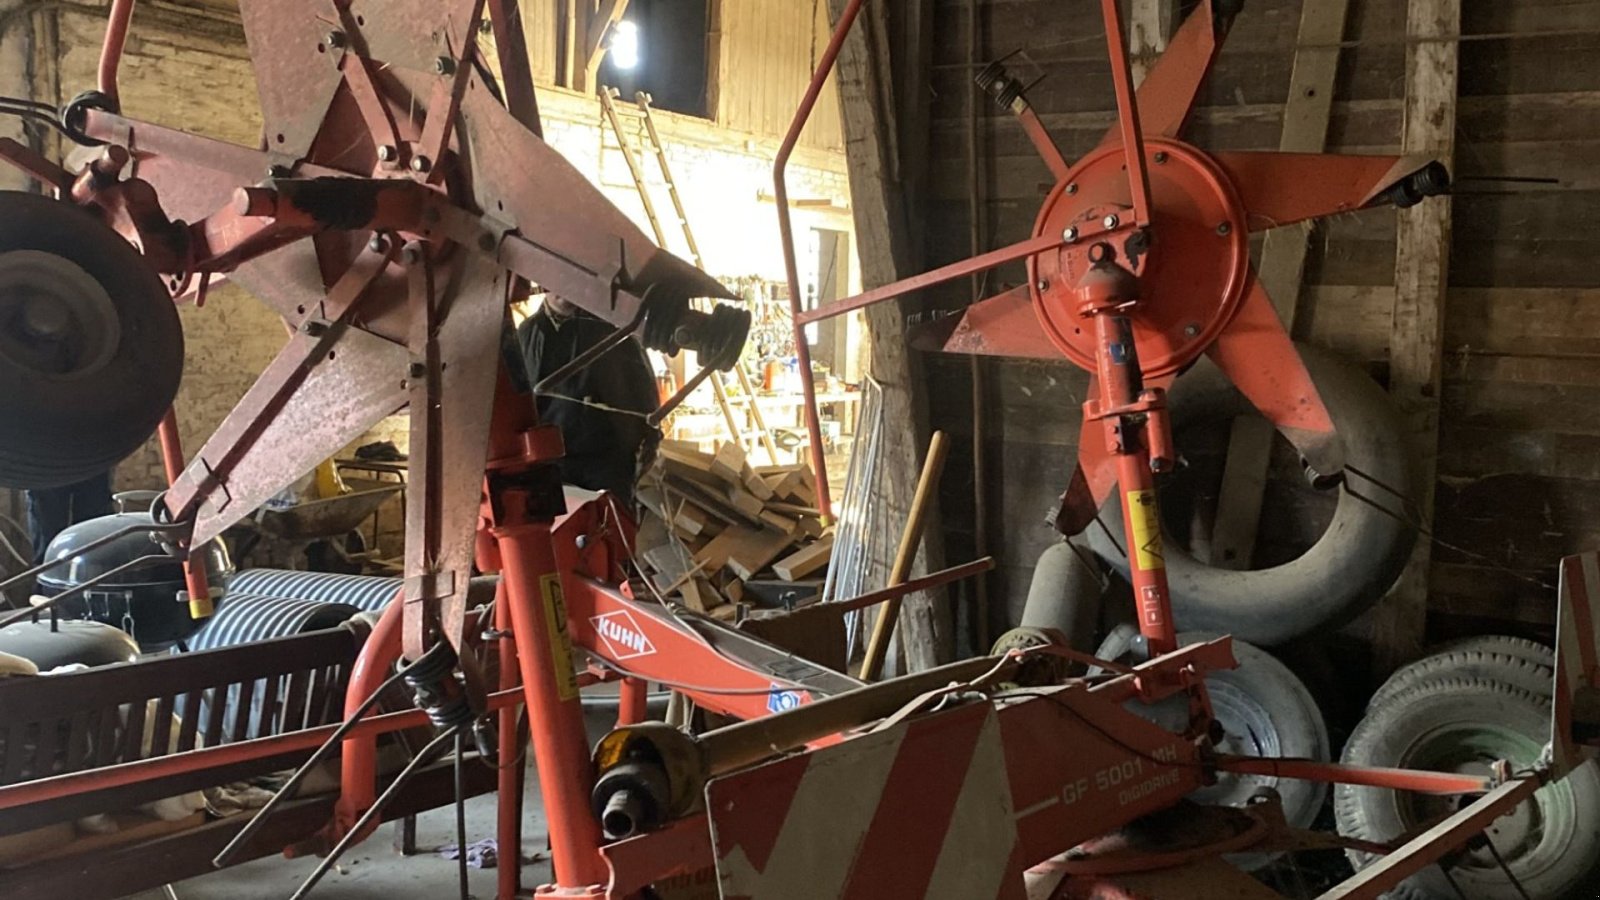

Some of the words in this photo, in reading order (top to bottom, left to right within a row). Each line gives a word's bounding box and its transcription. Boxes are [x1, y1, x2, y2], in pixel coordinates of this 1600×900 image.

[598, 617, 646, 654] KUHN
[1062, 777, 1089, 805] GF
[1095, 755, 1143, 791] 5001
[1151, 743, 1177, 768] MH
